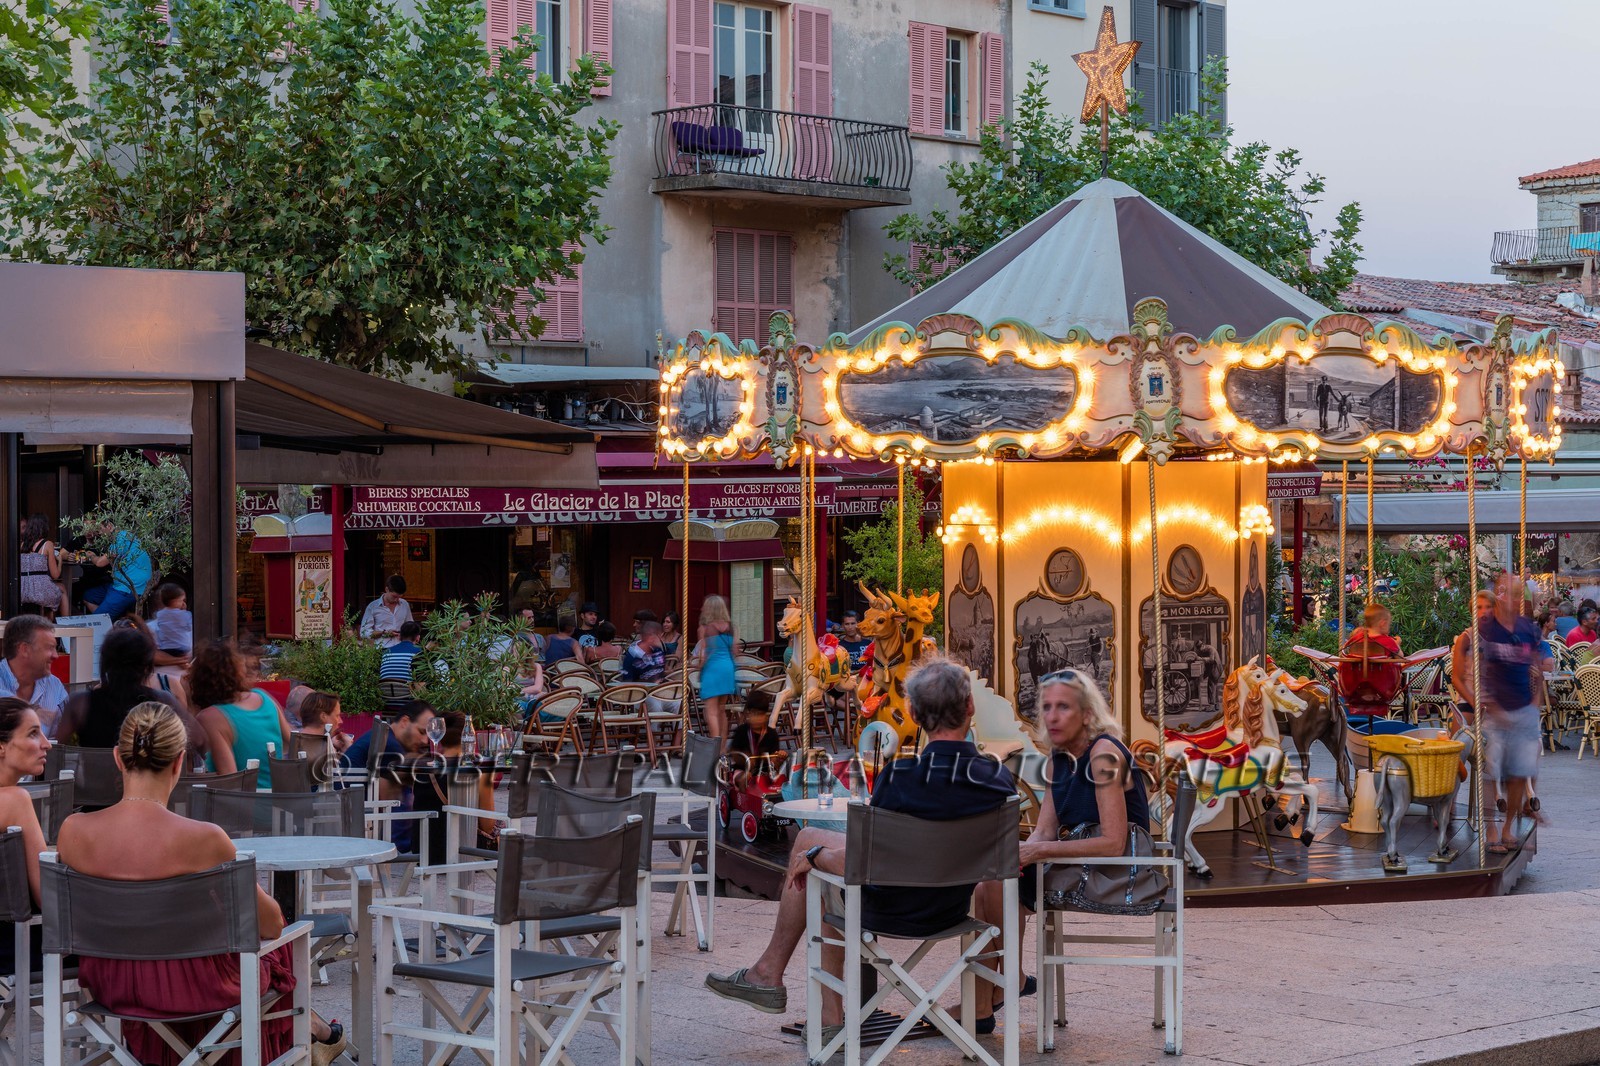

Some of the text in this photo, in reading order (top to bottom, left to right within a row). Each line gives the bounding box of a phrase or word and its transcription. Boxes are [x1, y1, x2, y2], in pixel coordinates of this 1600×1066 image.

[1282, 478, 1316, 486] SPECIALES
[368, 487, 469, 498] BIERES SPECIALES
[724, 484, 817, 494] GLACES ET SORBT
[1268, 488, 1293, 497] MONDE
[357, 501, 481, 512] RHUMERIE COCKTAILS
[503, 491, 690, 511] Le Glacier de la Place
[710, 495, 830, 508] FABRICATION ARTISNLE
[827, 500, 878, 515] HUMERIE
[343, 514, 426, 528] TISANALE
[1170, 606, 1213, 616] MON BAR
